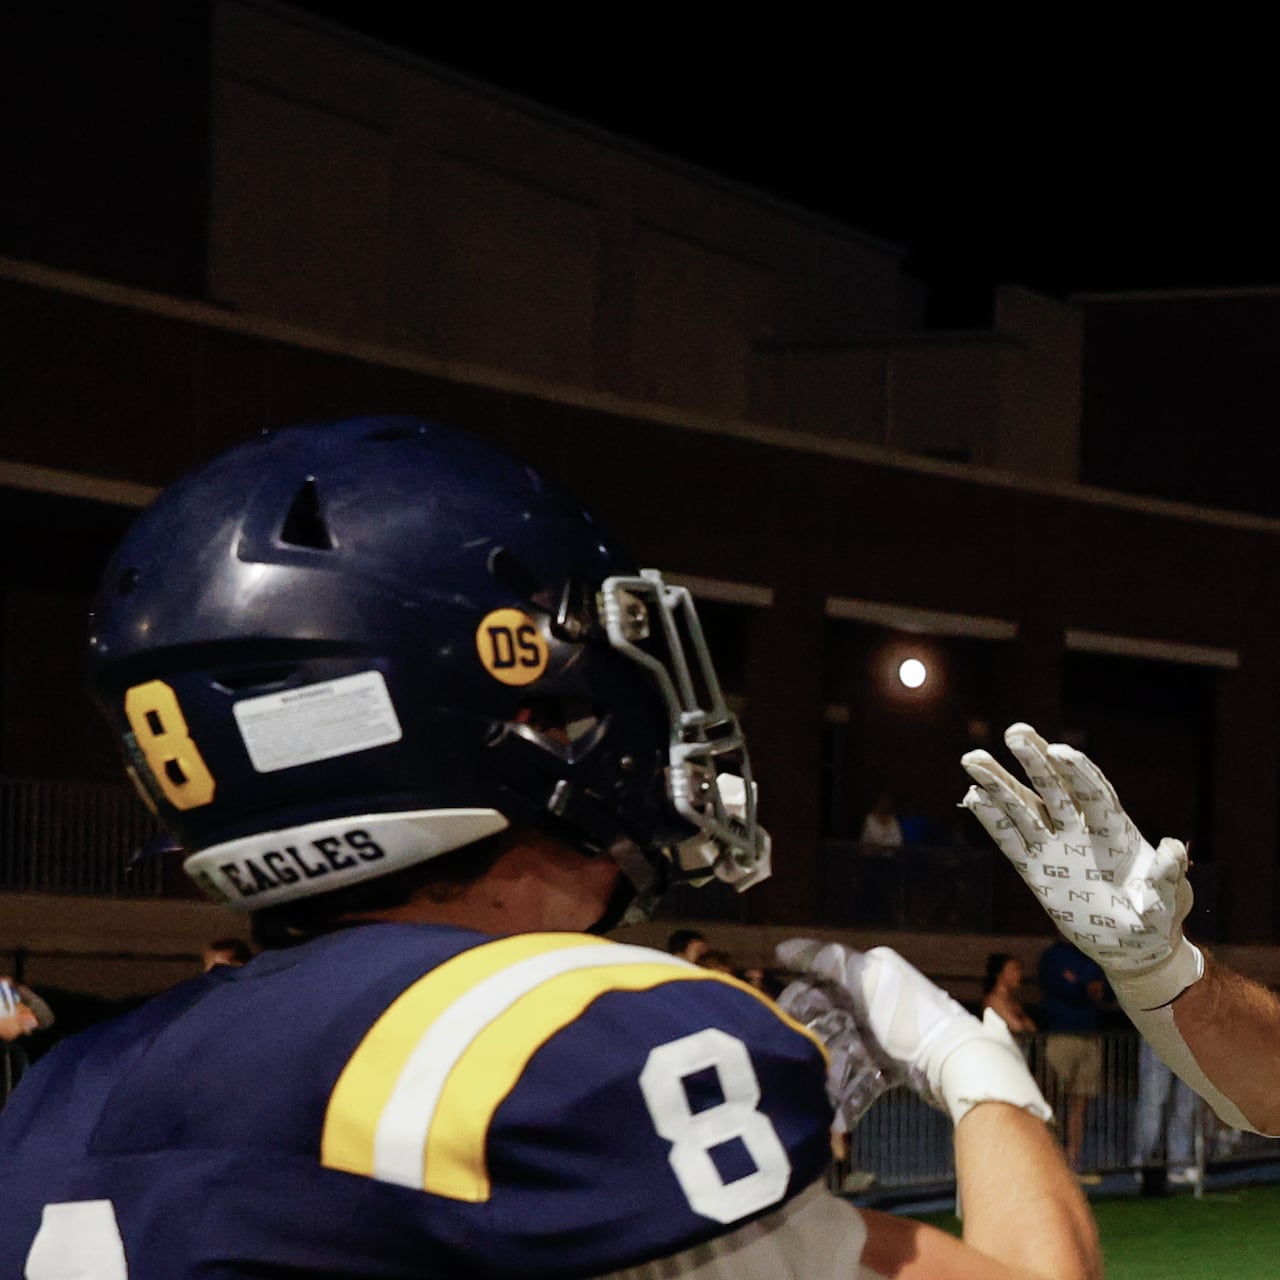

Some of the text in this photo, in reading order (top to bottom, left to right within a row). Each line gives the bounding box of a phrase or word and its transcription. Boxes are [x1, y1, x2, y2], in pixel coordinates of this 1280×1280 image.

[487, 624, 540, 668] DS
[125, 679, 216, 811] 8
[219, 829, 386, 896] EAGLES
[640, 1028, 792, 1225] 8
